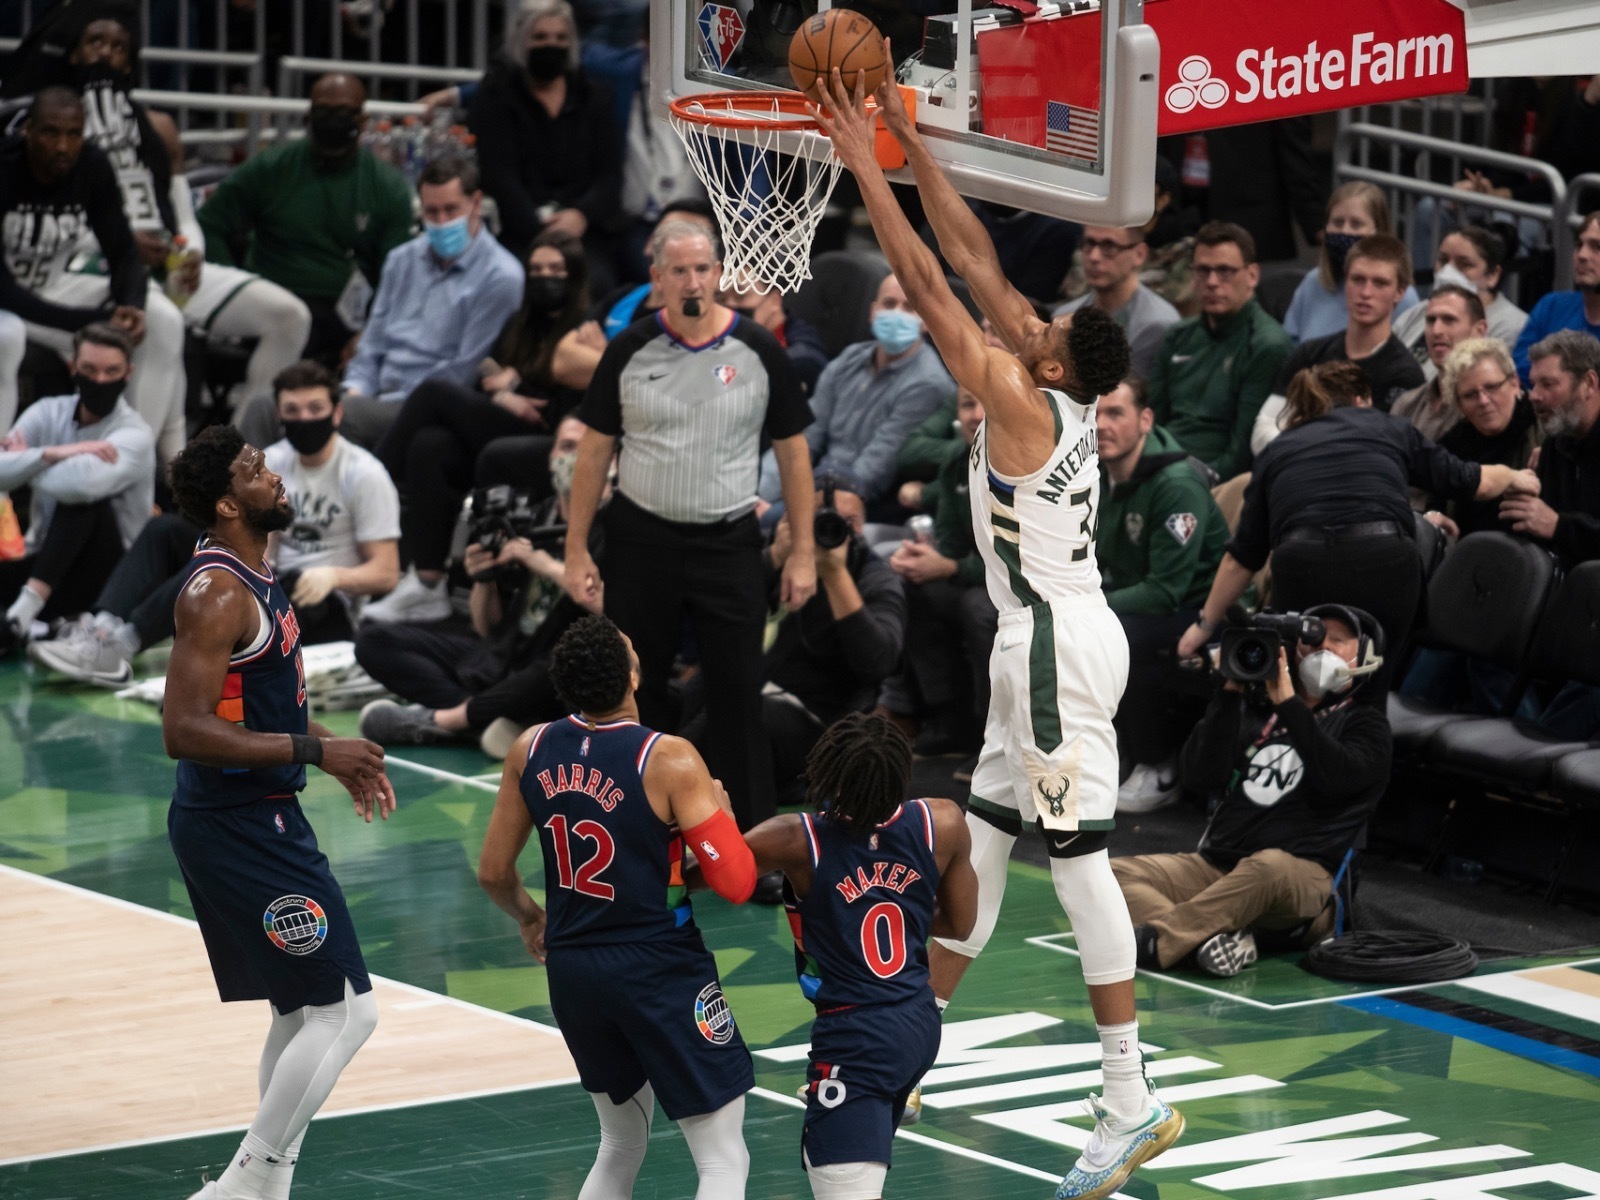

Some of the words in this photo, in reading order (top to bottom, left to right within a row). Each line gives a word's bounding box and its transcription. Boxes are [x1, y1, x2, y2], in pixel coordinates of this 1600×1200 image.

[537, 763, 625, 813] HARRIS
[543, 813, 616, 902] 12
[835, 861, 922, 904] MAXEY
[860, 901, 907, 979] 0
